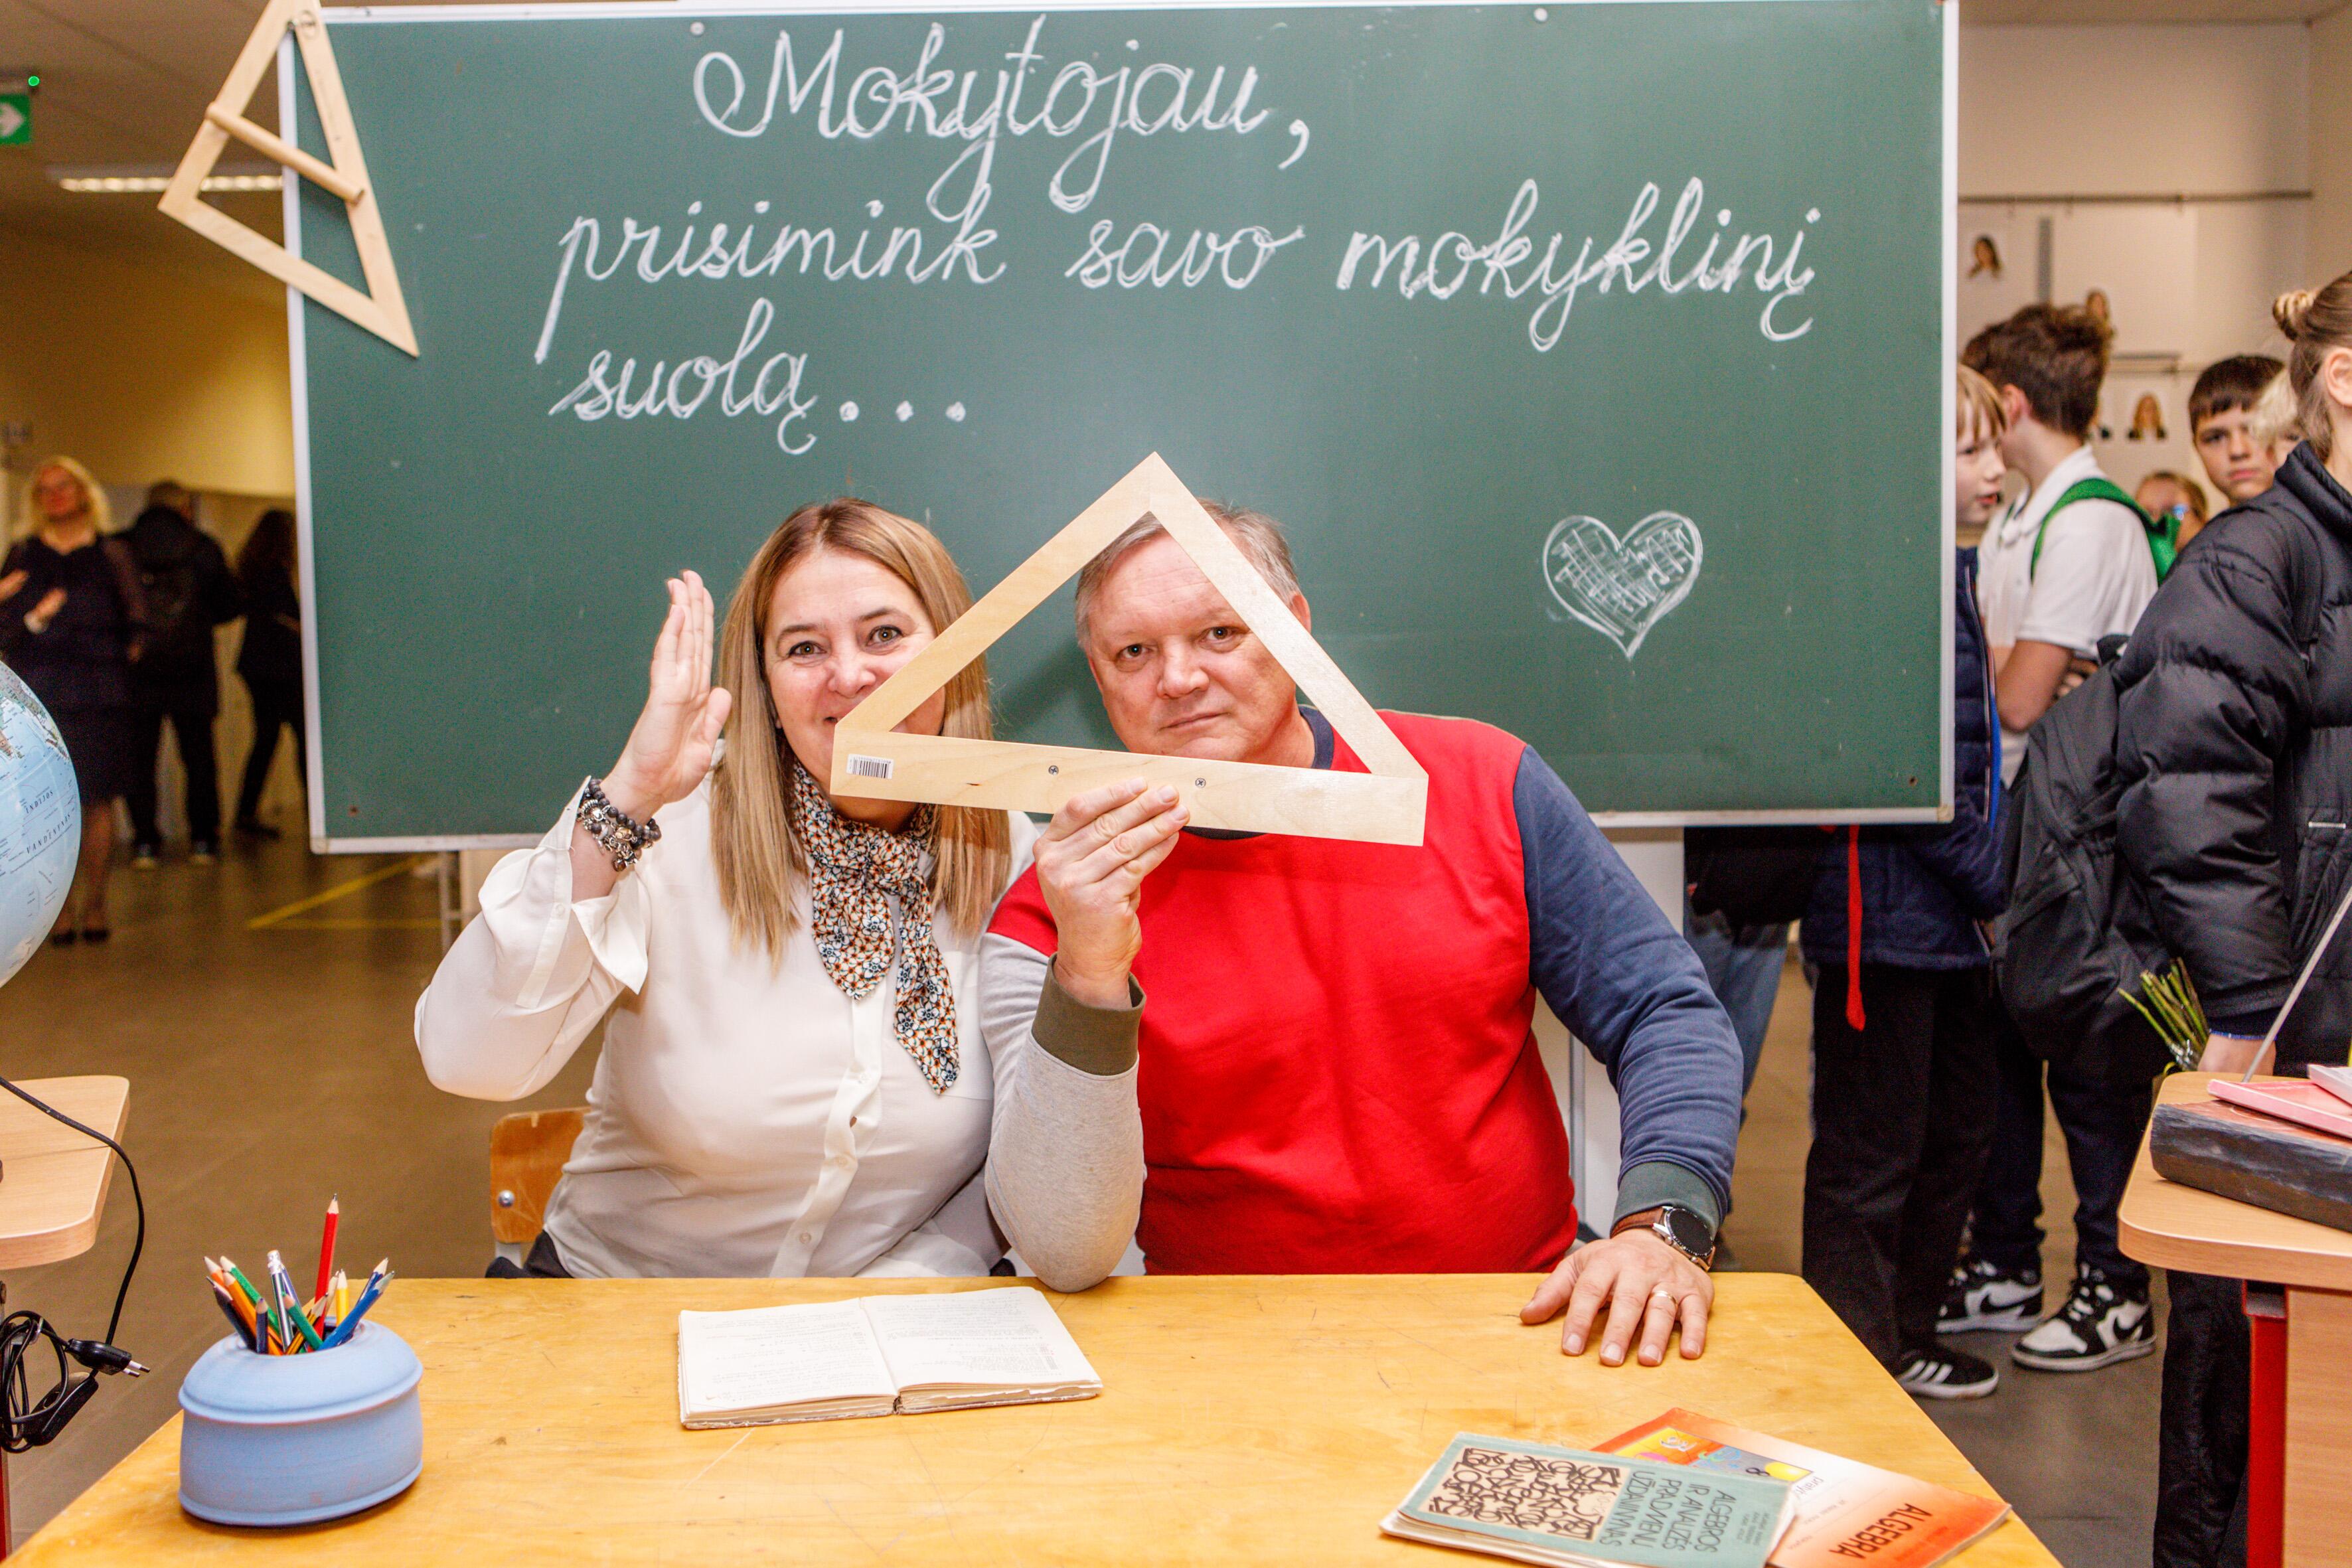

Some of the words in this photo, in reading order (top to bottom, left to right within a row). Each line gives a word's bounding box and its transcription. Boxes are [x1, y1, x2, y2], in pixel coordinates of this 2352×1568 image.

[692, 13, 1310, 222] Mokytojau,
[534, 183, 1006, 364] prisimink
[1064, 218, 1305, 289] savo
[1336, 176, 1821, 351] mokyklinį
[1599, 1470, 1656, 1547] UŽDAVINYNAS
[1687, 1483, 1711, 1496] IR
[1693, 1489, 1737, 1553] ALGEBROS
[1828, 1502, 1933, 1560] ALGEBRA
